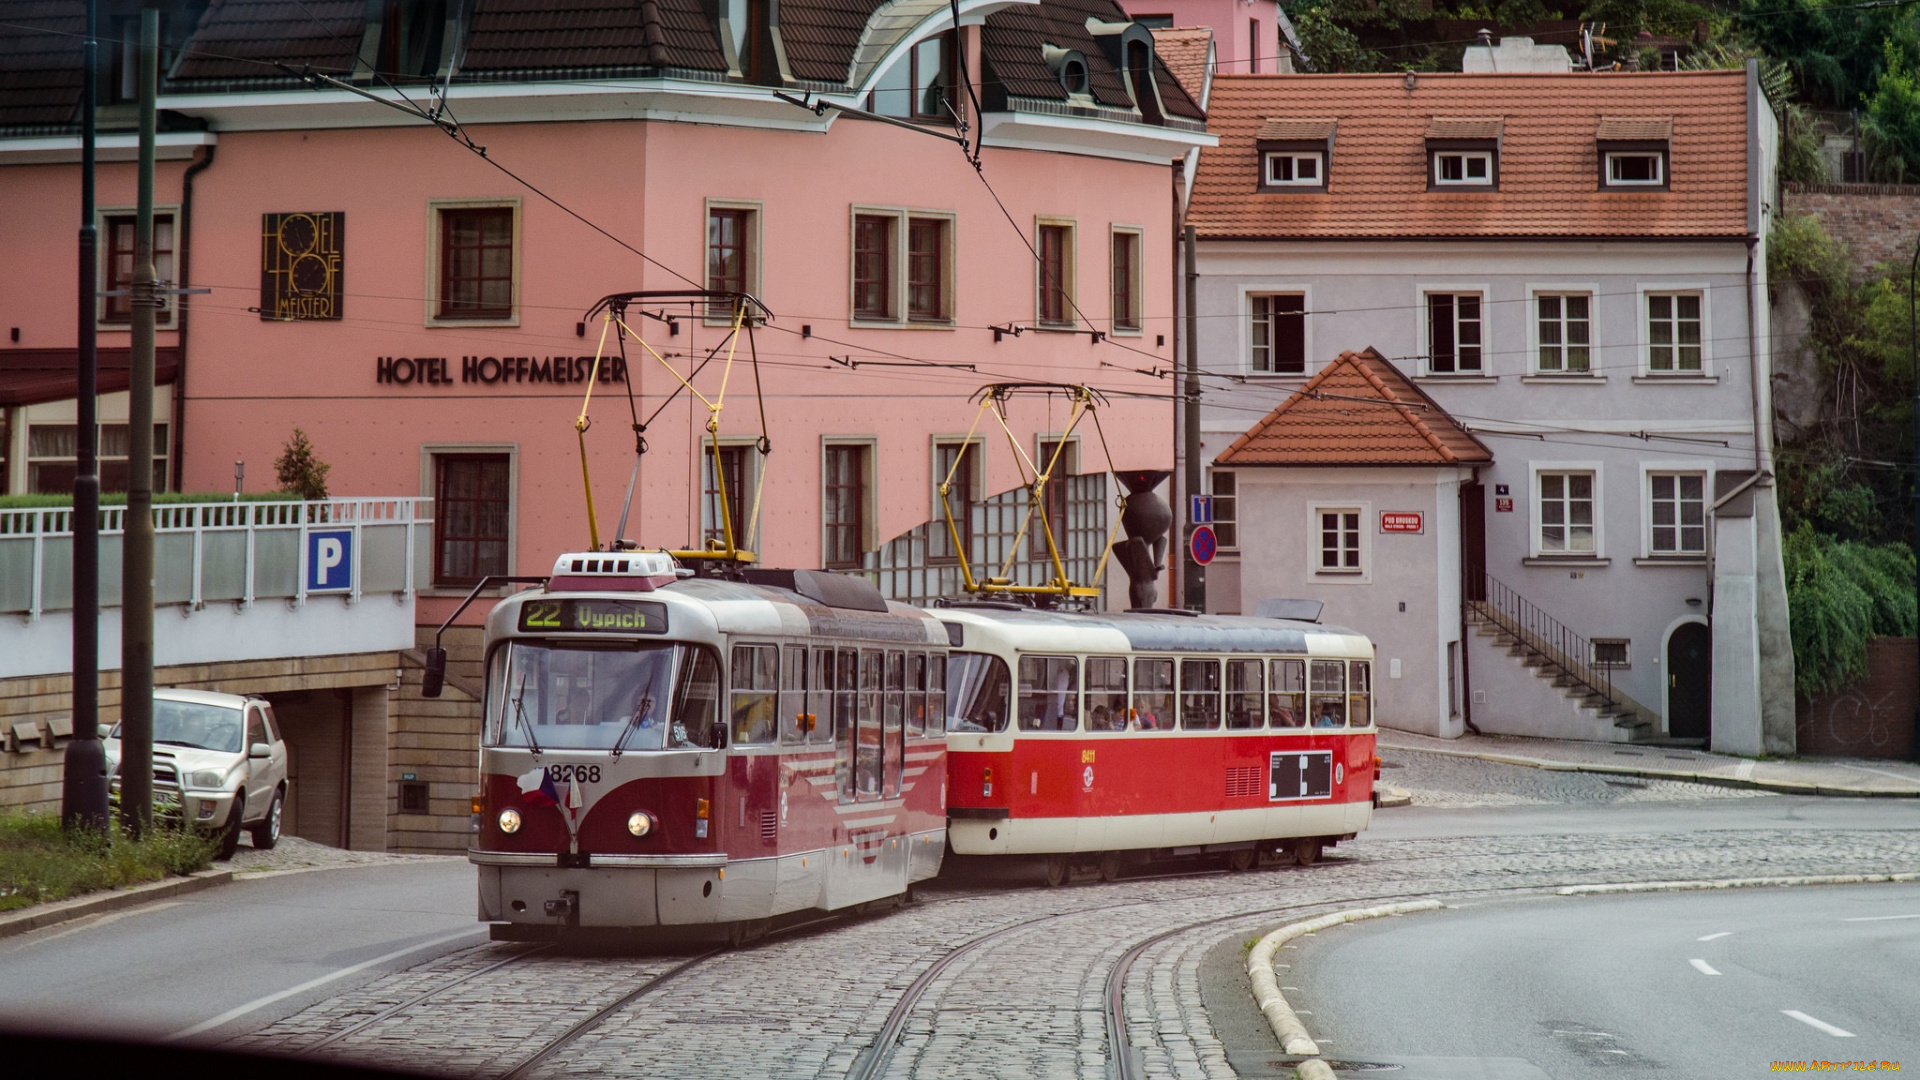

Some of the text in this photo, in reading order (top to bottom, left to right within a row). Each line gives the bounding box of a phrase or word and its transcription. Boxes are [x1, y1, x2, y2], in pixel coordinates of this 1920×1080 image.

[262, 212, 340, 270] HOTEL
[280, 298, 329, 319] MEISTER
[376, 355, 626, 384] HOTEL HOFFMEISTER
[1384, 516, 1395, 524] POD
[317, 538, 342, 584] P
[527, 602, 646, 628] 22 Vypich
[1081, 749, 1096, 764] 8411
[551, 764, 601, 783] 8268
